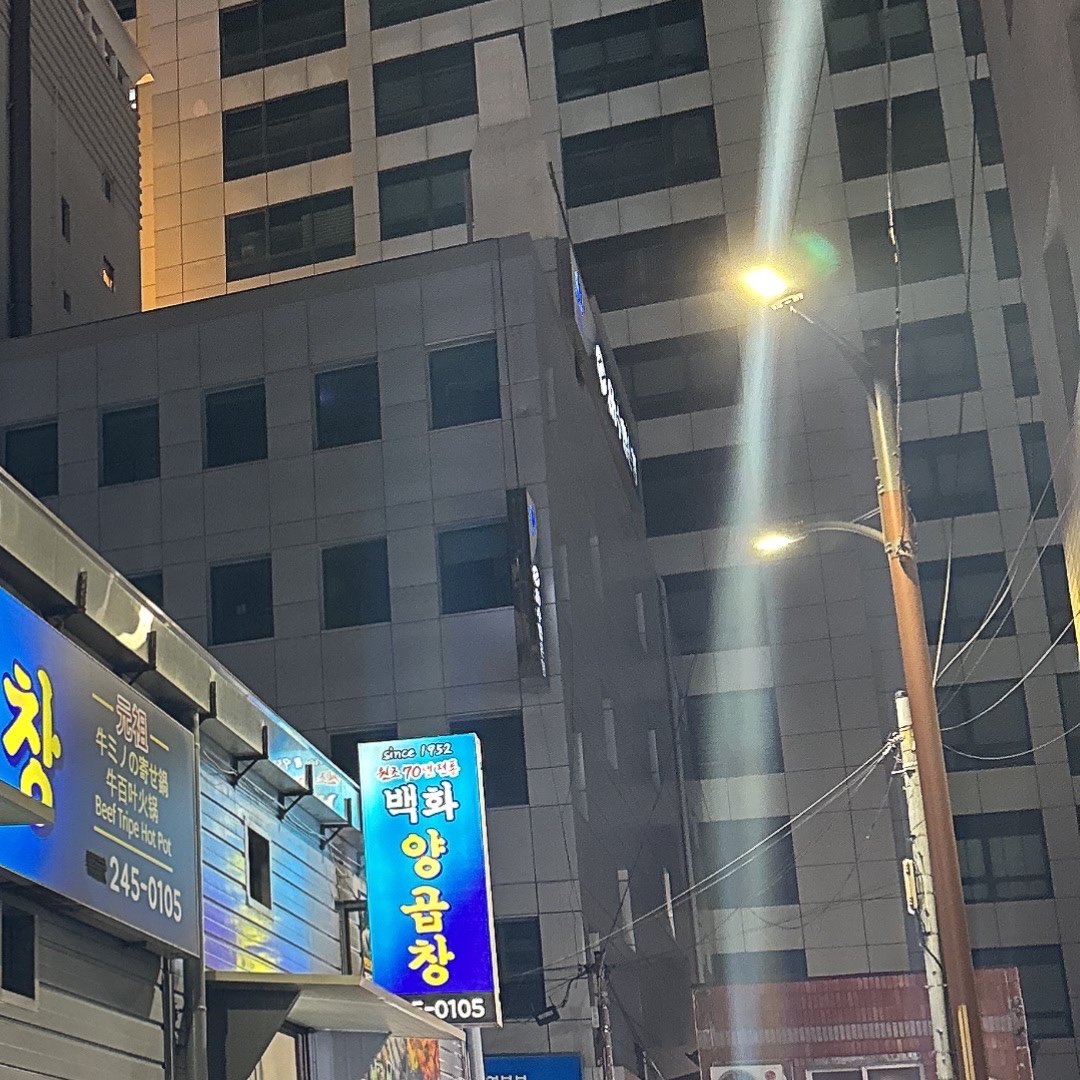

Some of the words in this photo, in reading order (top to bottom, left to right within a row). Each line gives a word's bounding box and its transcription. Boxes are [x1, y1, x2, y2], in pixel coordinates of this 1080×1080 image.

[382, 746, 416, 760] since
[420, 742, 453, 757] 1952
[95, 795, 116, 825] Beef
[118, 808, 139, 839] Tripe
[141, 821, 156, 848] Hot
[158, 831, 172, 857] Pot
[383, 780, 460, 824] 백화
[110, 856, 182, 922] 245-0105
[400, 828, 455, 986] 양곱창
